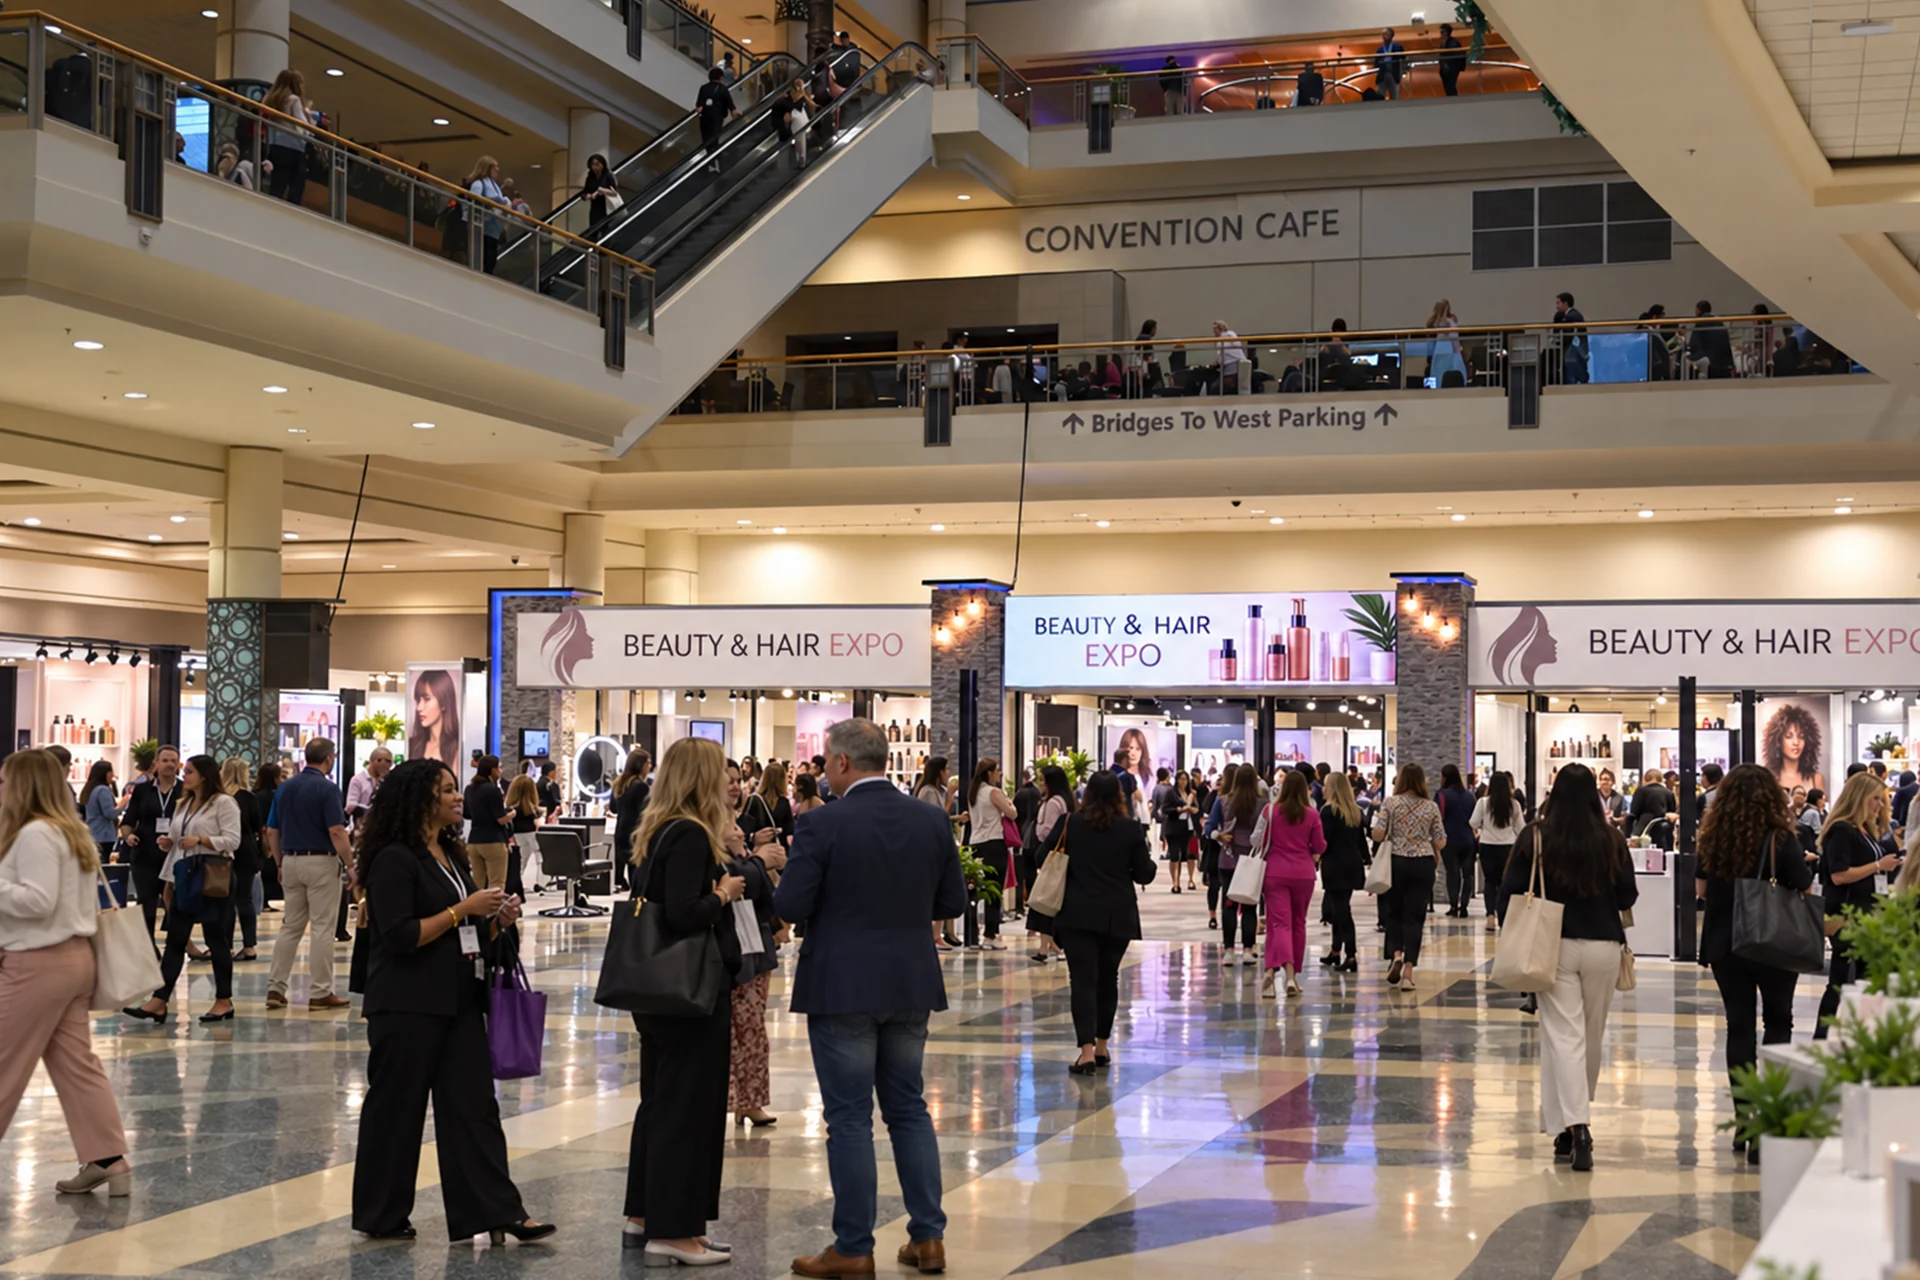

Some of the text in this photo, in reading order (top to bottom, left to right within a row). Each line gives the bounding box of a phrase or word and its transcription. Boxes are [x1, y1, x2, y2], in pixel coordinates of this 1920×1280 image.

[1025, 208, 1340, 253] CONVENTION CAFE
[1091, 406, 1366, 437] Bridges To West Parking
[1034, 613, 1212, 636] BEAUTY & HAIR
[624, 632, 904, 657] BEAUTY & HAIR EXPO
[1589, 628, 1713, 655] BEAUTY
[1722, 628, 1744, 655] &
[1755, 628, 1832, 655] HAIR
[1085, 643, 1162, 668] EXPO
